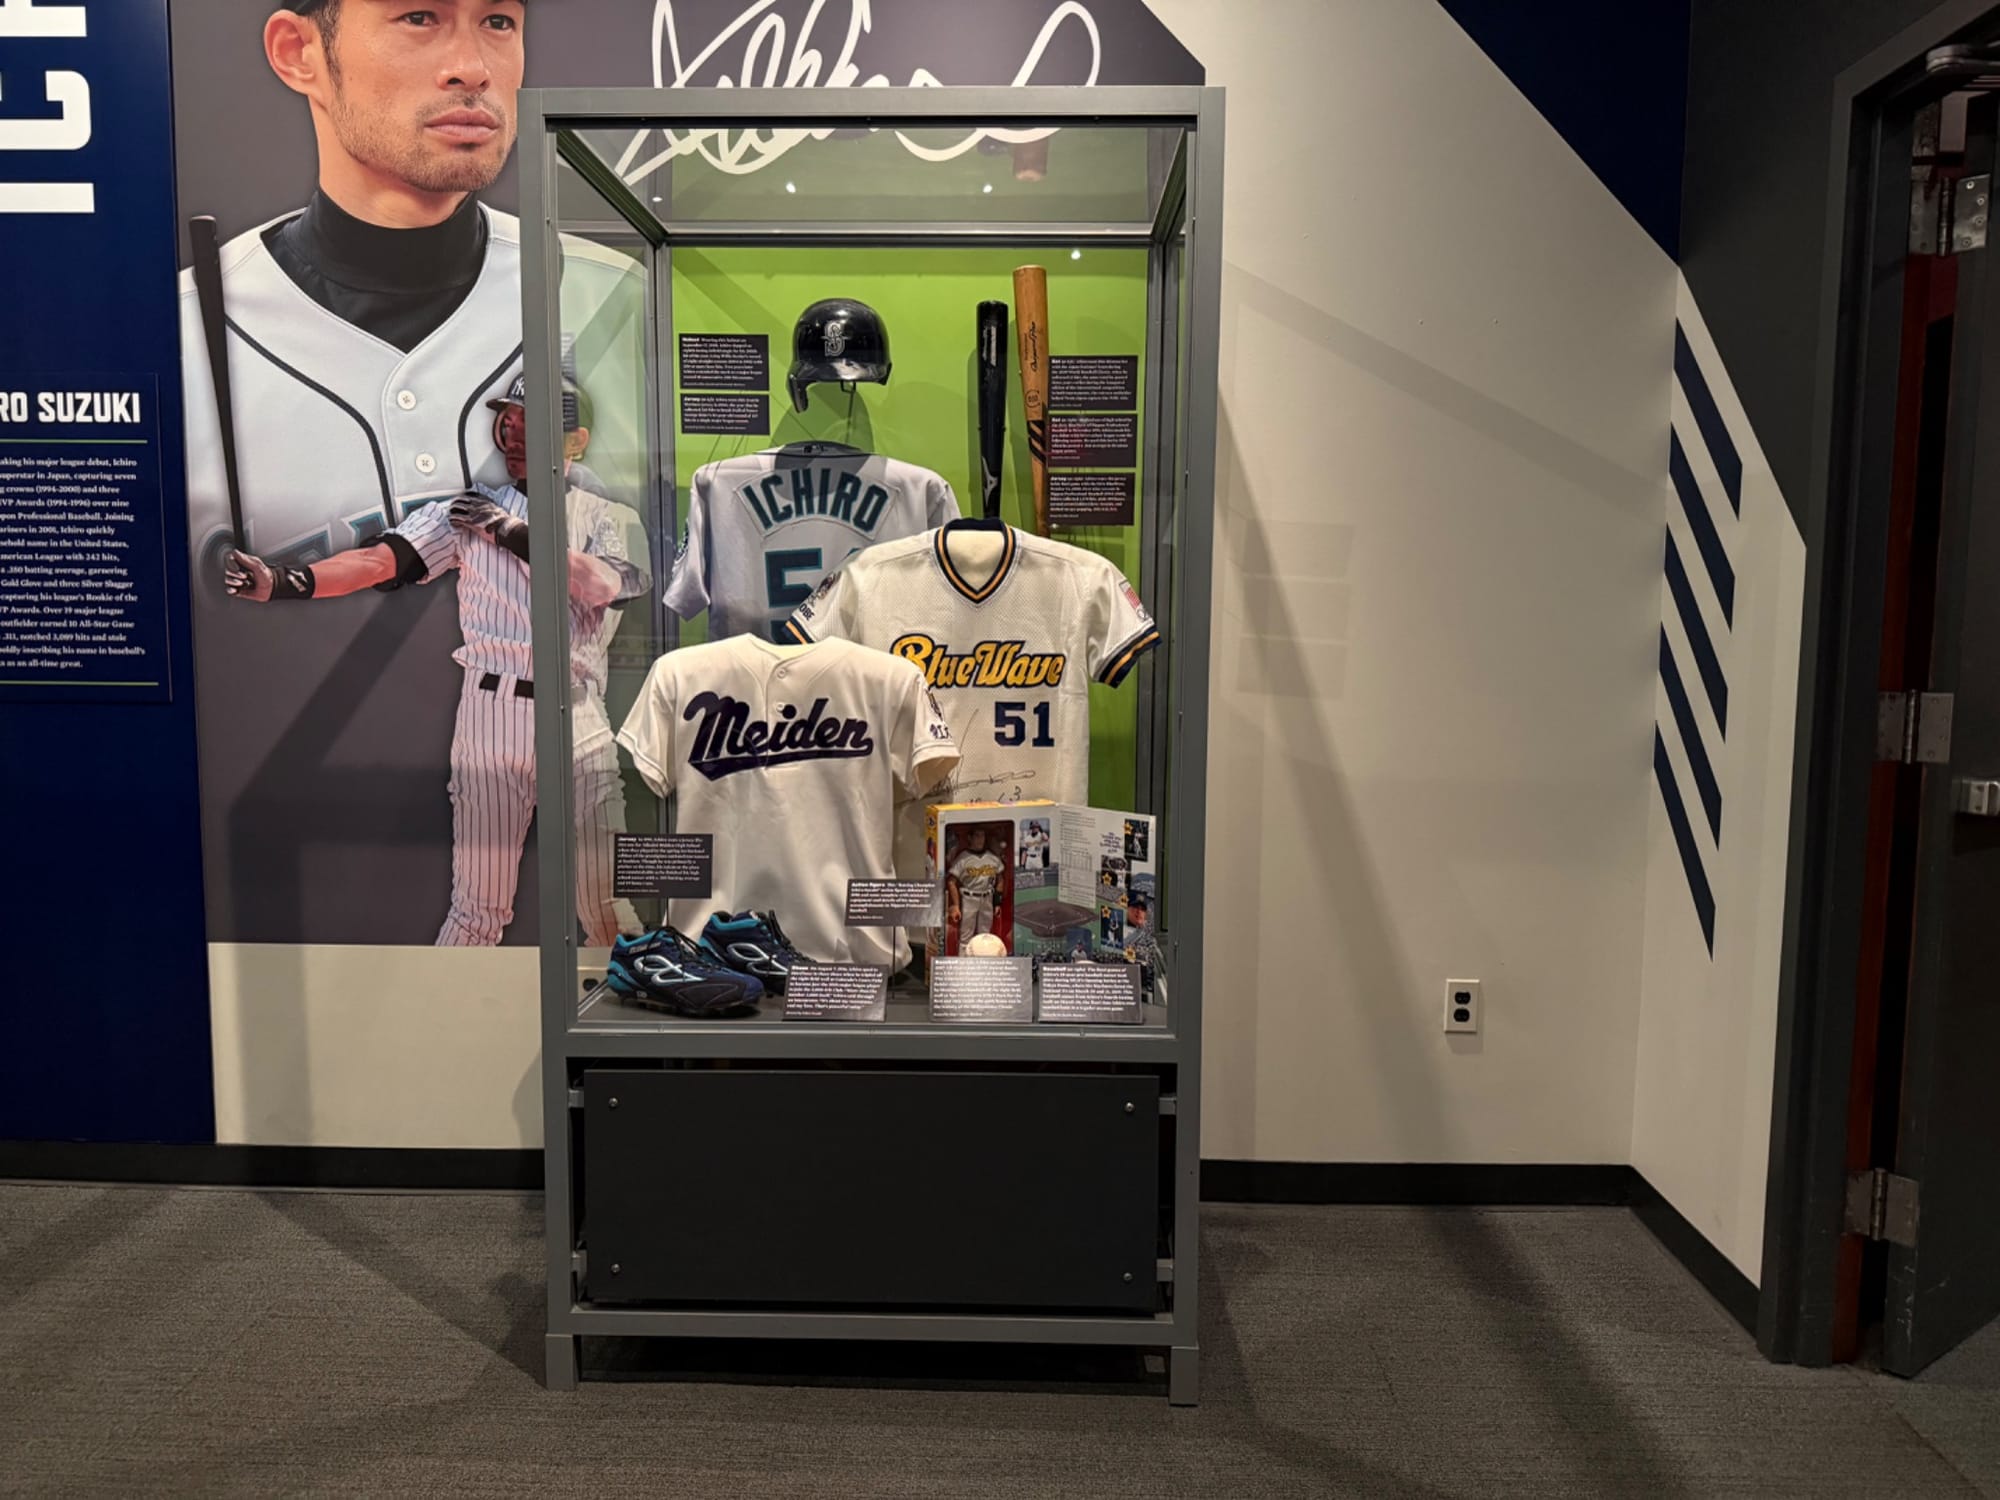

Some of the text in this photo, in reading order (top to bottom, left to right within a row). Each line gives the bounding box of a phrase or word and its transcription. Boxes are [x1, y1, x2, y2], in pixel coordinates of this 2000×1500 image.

[37, 391, 141, 423] SUZUKI
[23, 457, 35, 466] his
[36, 460, 59, 469] major
[60, 458, 86, 469] league
[113, 459, 137, 468] Ichiro
[37, 471, 45, 480] in
[74, 472, 113, 483] capturing
[82, 485, 97, 494] and
[99, 485, 120, 494] three
[15, 498, 45, 507] Awards
[112, 499, 129, 508] nine
[742, 467, 889, 533] ICHIRO
[18, 511, 66, 520] Professional
[105, 512, 133, 523] Joining
[29, 525, 36, 534] in
[61, 525, 84, 534] Ichiro
[86, 525, 114, 536] quickly
[50, 538, 58, 547] in
[60, 538, 72, 547] the
[75, 539, 101, 548] United
[35, 551, 63, 562] League
[66, 552, 84, 561] with
[24, 565, 53, 576] batting
[88, 565, 128, 576] garnering
[1, 578, 19, 587] Gold
[21, 578, 41, 587] Glove
[44, 578, 57, 587] and
[59, 578, 79, 587] three
[82, 579, 103, 588] Silver
[41, 591, 51, 600] his
[87, 592, 111, 601] Rookie
[115, 592, 123, 601] of
[125, 592, 137, 601] the
[764, 547, 852, 645] 5
[43, 605, 63, 614] Over
[74, 607, 97, 616] major
[98, 606, 124, 617] league
[799, 603, 815, 621] OBE
[40, 618, 67, 627] earned
[79, 619, 110, 628] All-Star
[112, 619, 134, 628] Game
[20, 631, 51, 640] notched
[75, 632, 90, 641] hits
[92, 632, 107, 641] and
[108, 632, 126, 641] stole
[23, 645, 61, 656] inscribing
[63, 645, 74, 654] his
[99, 646, 106, 655] in
[28, 658, 58, 667] all-time
[994, 700, 1055, 748] 51
[683, 690, 875, 780] Meiden
